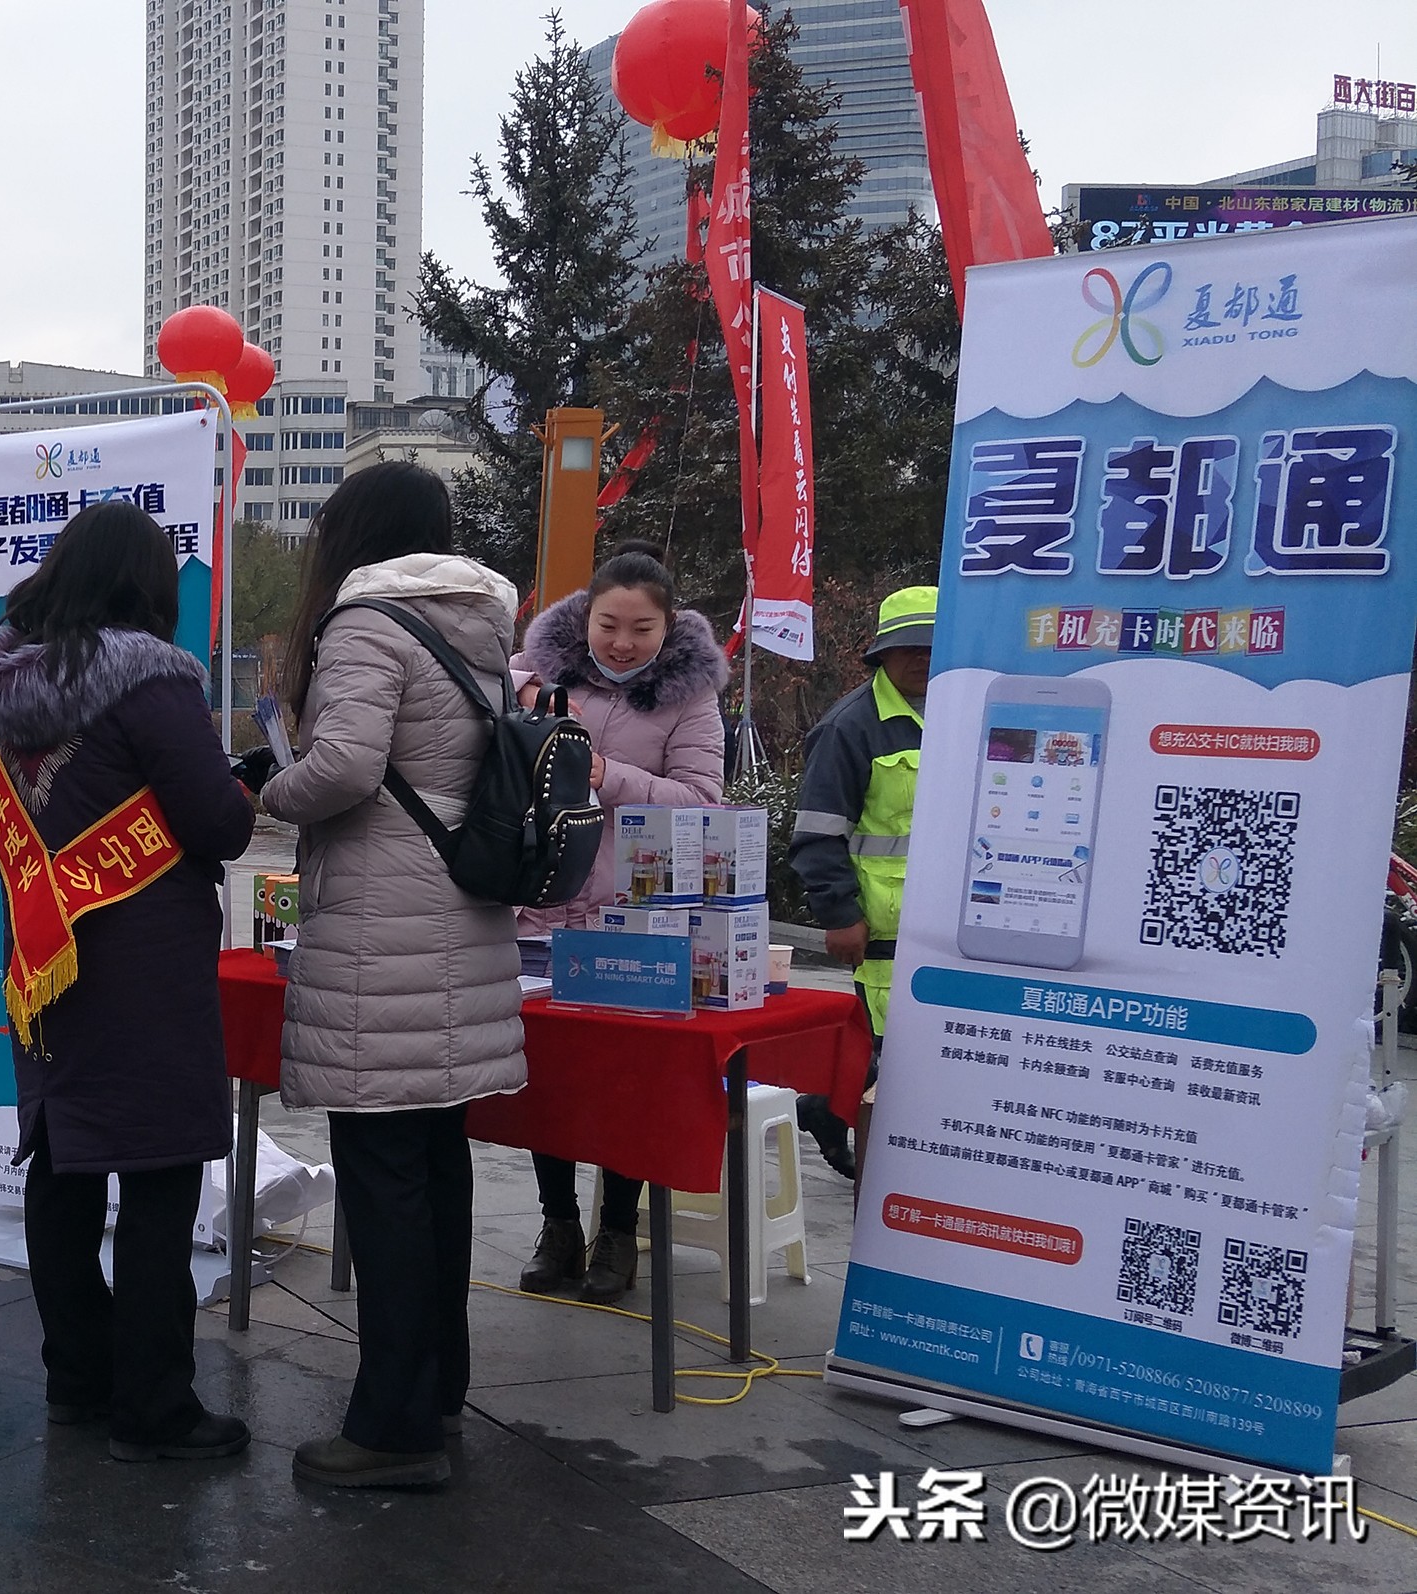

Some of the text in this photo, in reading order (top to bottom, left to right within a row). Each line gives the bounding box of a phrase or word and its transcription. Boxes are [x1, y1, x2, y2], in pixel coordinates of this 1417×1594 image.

[1165, 195, 1417, 214] 中国·北山东部家居建材(物流)
[1182, 274, 1303, 332] 夏都通
[1182, 326, 1300, 349] XIADU TONG
[779, 316, 813, 577] 支付先看云闪付
[958, 423, 1398, 582] 夏都通
[164, 522, 199, 555] 程
[1028, 611, 1285, 653] 手机充卡时代来临
[595, 957, 677, 976] 西宁智能一卡通
[626, 974, 652, 985] SMART
[654, 976, 676, 986] CARD
[1021, 986, 1189, 1032] 夏都通APP功能
[944, 1020, 1264, 1079] 夏都通卡充值 卡片在线挂失 公交站点查询 话费充值服务
[940, 1045, 1261, 1107] 查阅本地新闻 卡内余额查询 客服中心查询 接收最新资讯
[991, 1098, 1038, 1118] 手机具备
[1041, 1106, 1064, 1122] NFC
[940, 1117, 997, 1138] 手机不具备
[999, 1126, 1022, 1142] NFC
[851, 1299, 993, 1344] 西宁智能一卡通有限责任公司
[1230, 1332, 1284, 1355] 微博二维码
